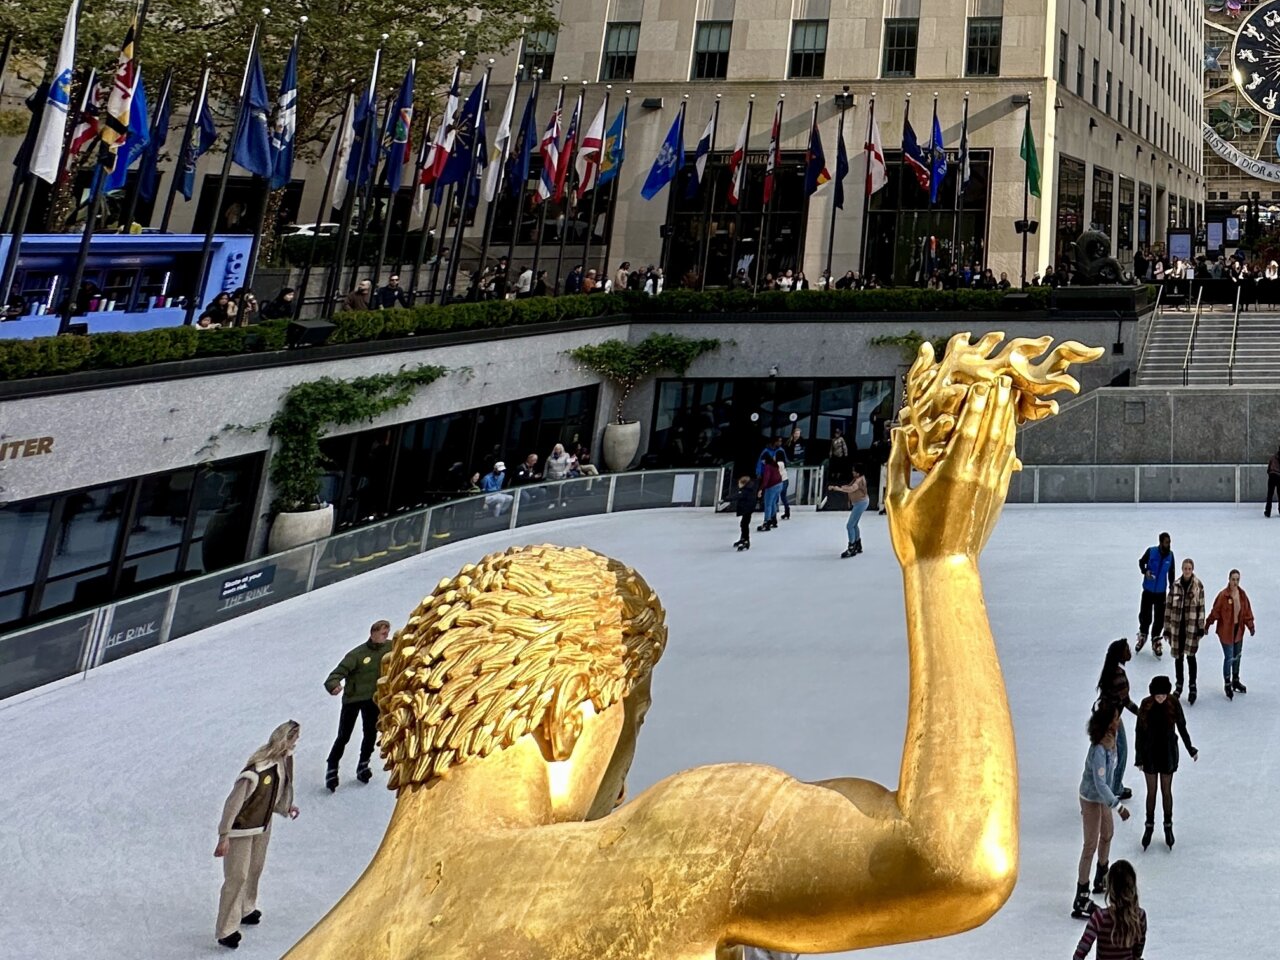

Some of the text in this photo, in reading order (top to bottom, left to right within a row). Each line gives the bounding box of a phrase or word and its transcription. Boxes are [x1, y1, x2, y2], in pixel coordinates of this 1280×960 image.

[1203, 127, 1239, 162] HRISTIAN
[1242, 158, 1267, 178] DIOR
[225, 584, 271, 608] THE RINK
[107, 621, 156, 646] HE RINK
